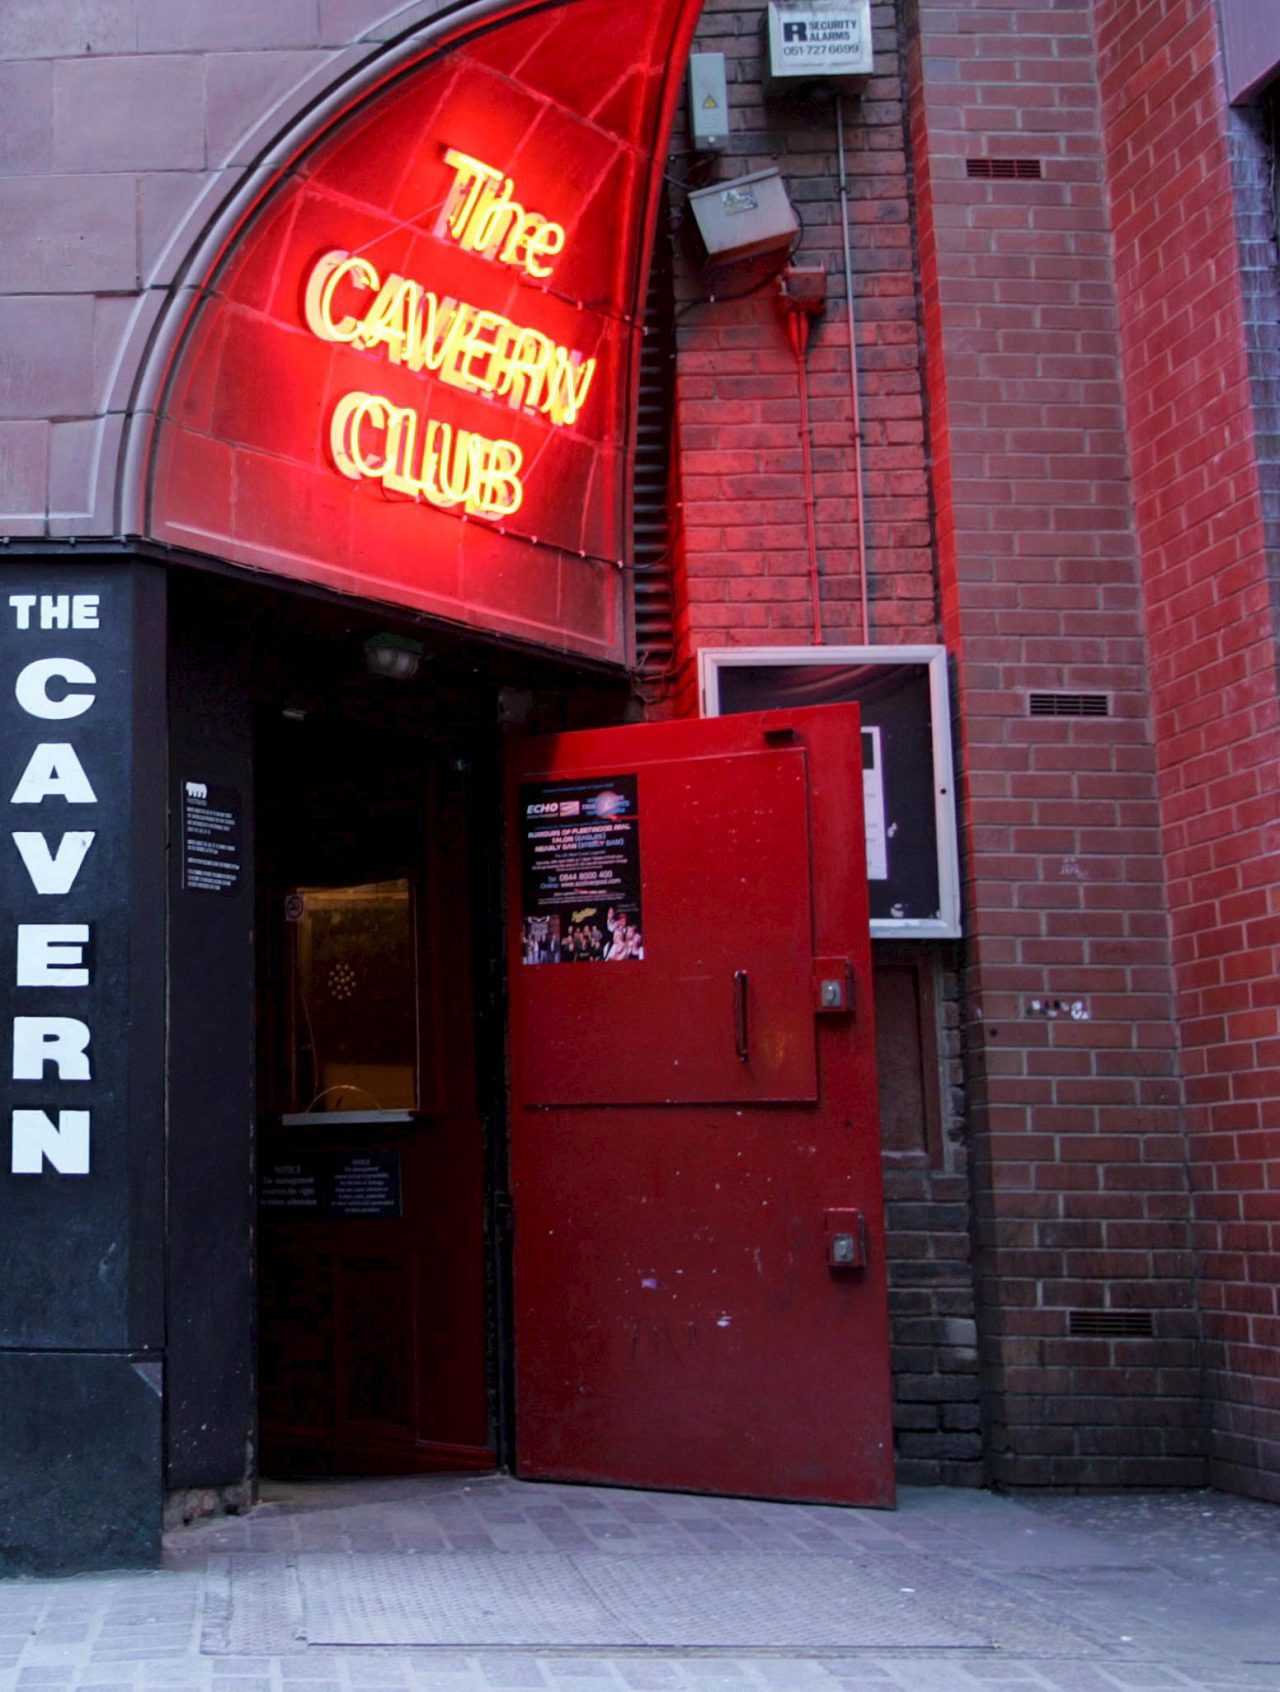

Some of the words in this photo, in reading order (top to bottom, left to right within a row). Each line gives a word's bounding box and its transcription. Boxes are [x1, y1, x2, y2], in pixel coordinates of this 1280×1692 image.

[783, 22, 807, 42] R
[808, 20, 857, 30] SECURITY
[810, 31, 850, 42] ALARMS
[432, 148, 566, 279] The
[304, 249, 596, 427] CAVERN
[330, 390, 523, 521] CLUB
[9, 594, 100, 630] THE
[526, 802, 559, 815] ECHO
[559, 873, 577, 882] 0844
[578, 871, 597, 881] 8000
[598, 870, 613, 879] 400
[10, 657, 99, 1174] CAVERN
